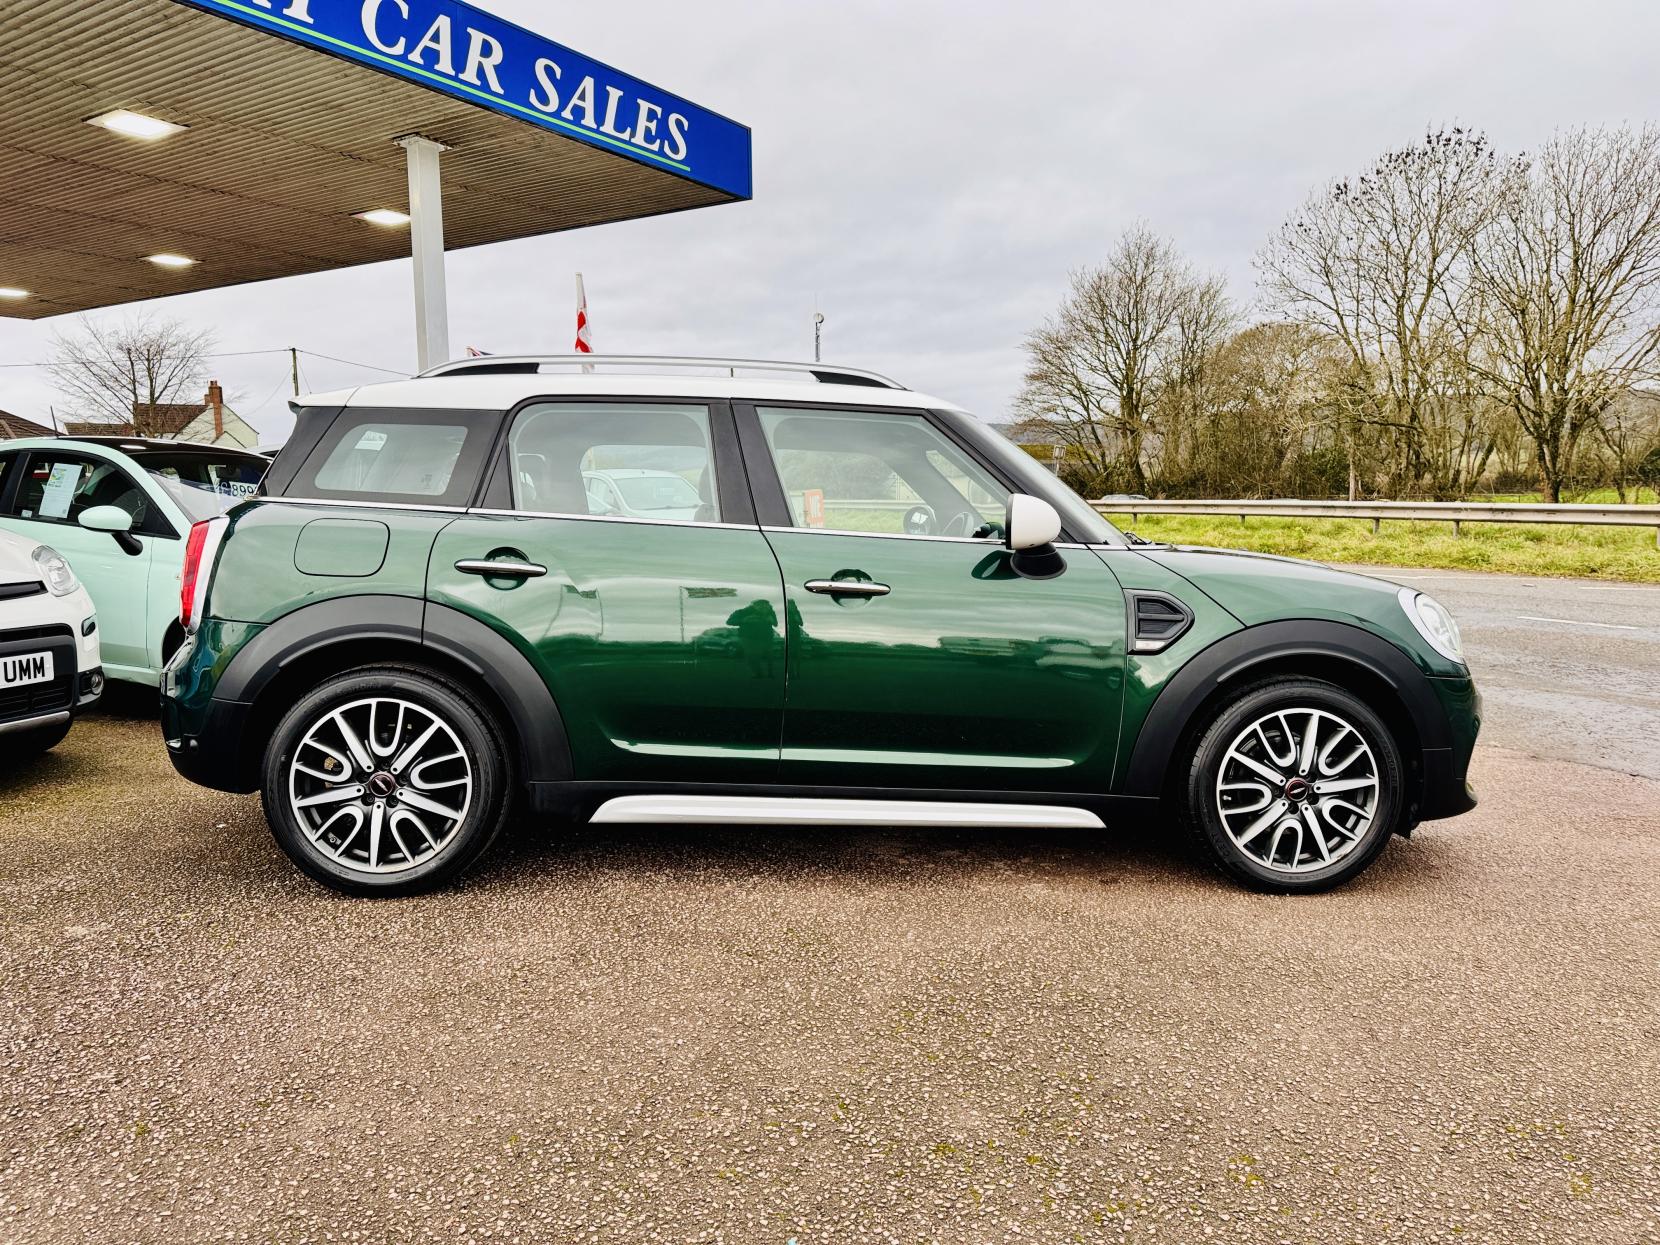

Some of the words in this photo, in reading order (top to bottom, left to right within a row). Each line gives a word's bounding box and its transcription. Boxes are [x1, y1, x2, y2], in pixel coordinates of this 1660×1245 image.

[361, 0, 504, 95] CAR
[529, 58, 689, 161] SALES
[3, 656, 46, 683] UMM
